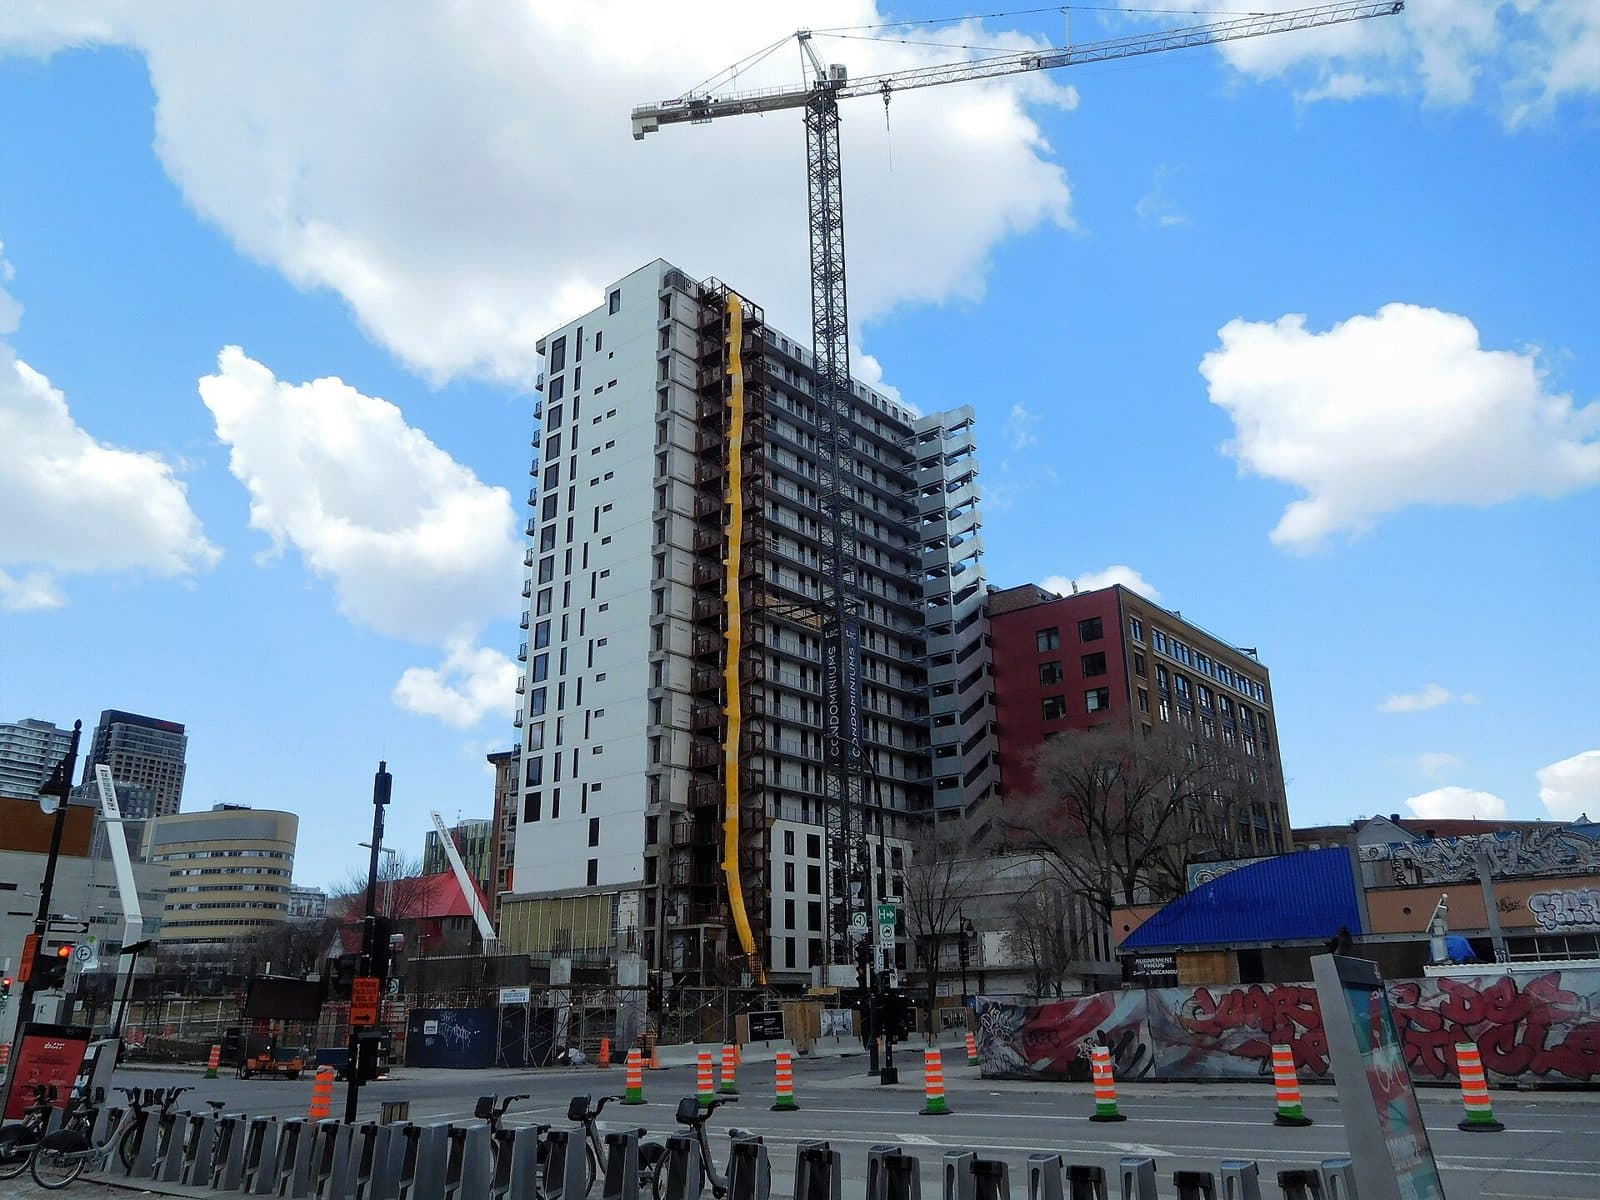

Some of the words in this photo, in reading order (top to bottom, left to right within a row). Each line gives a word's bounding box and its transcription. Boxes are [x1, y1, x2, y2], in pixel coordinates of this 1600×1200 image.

[827, 646, 840, 757] CONDOMINIUMS
[848, 647, 861, 758] CONDOMINIUMS
[878, 908, 886, 920] H
